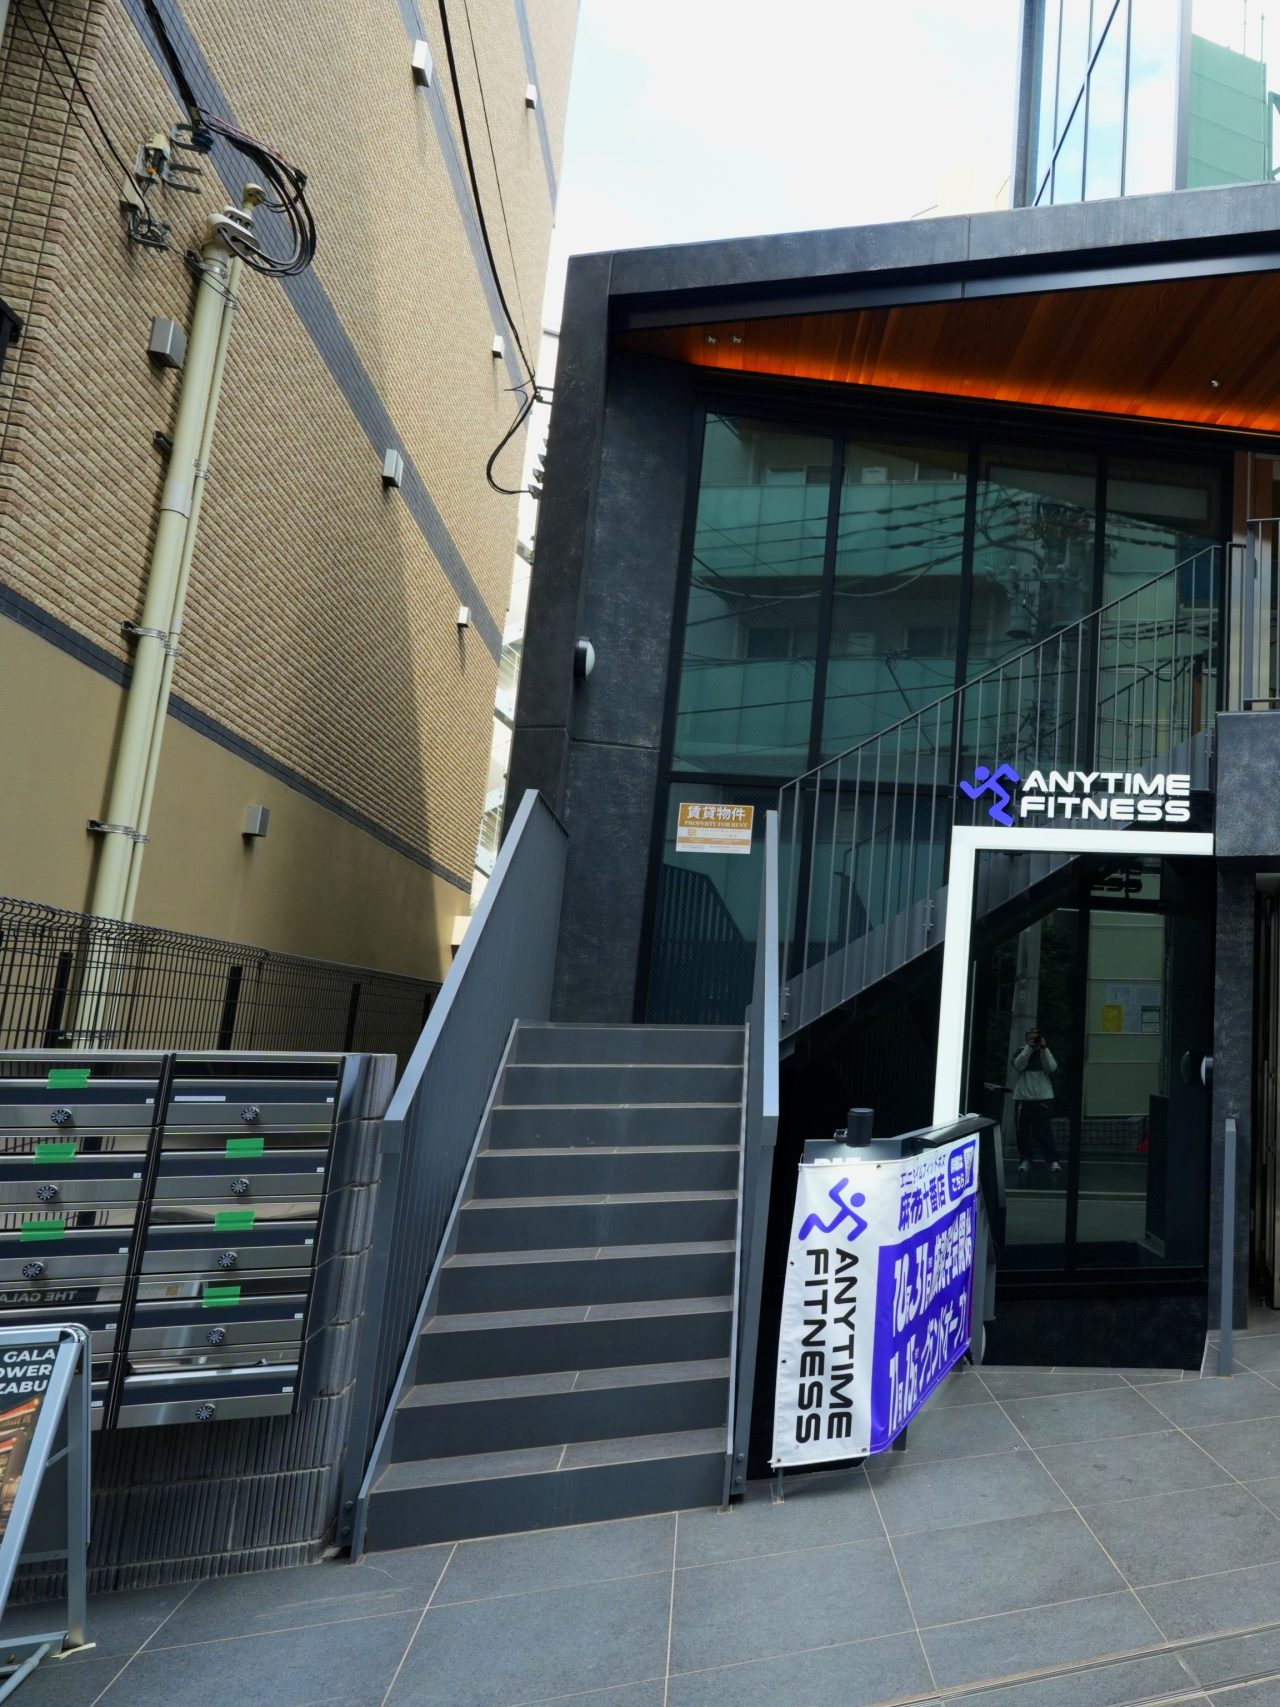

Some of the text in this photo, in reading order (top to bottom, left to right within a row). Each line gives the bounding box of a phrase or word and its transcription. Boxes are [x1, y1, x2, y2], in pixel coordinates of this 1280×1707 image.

[1022, 769, 1191, 796] ANYTIME
[687, 805, 746, 821] 賃貸物件
[1020, 796, 1191, 822] FITNESS
[3, 1348, 56, 1363] GALA
[795, 1248, 829, 1444] FITNESS
[826, 1247, 860, 1440] ANYTIME
